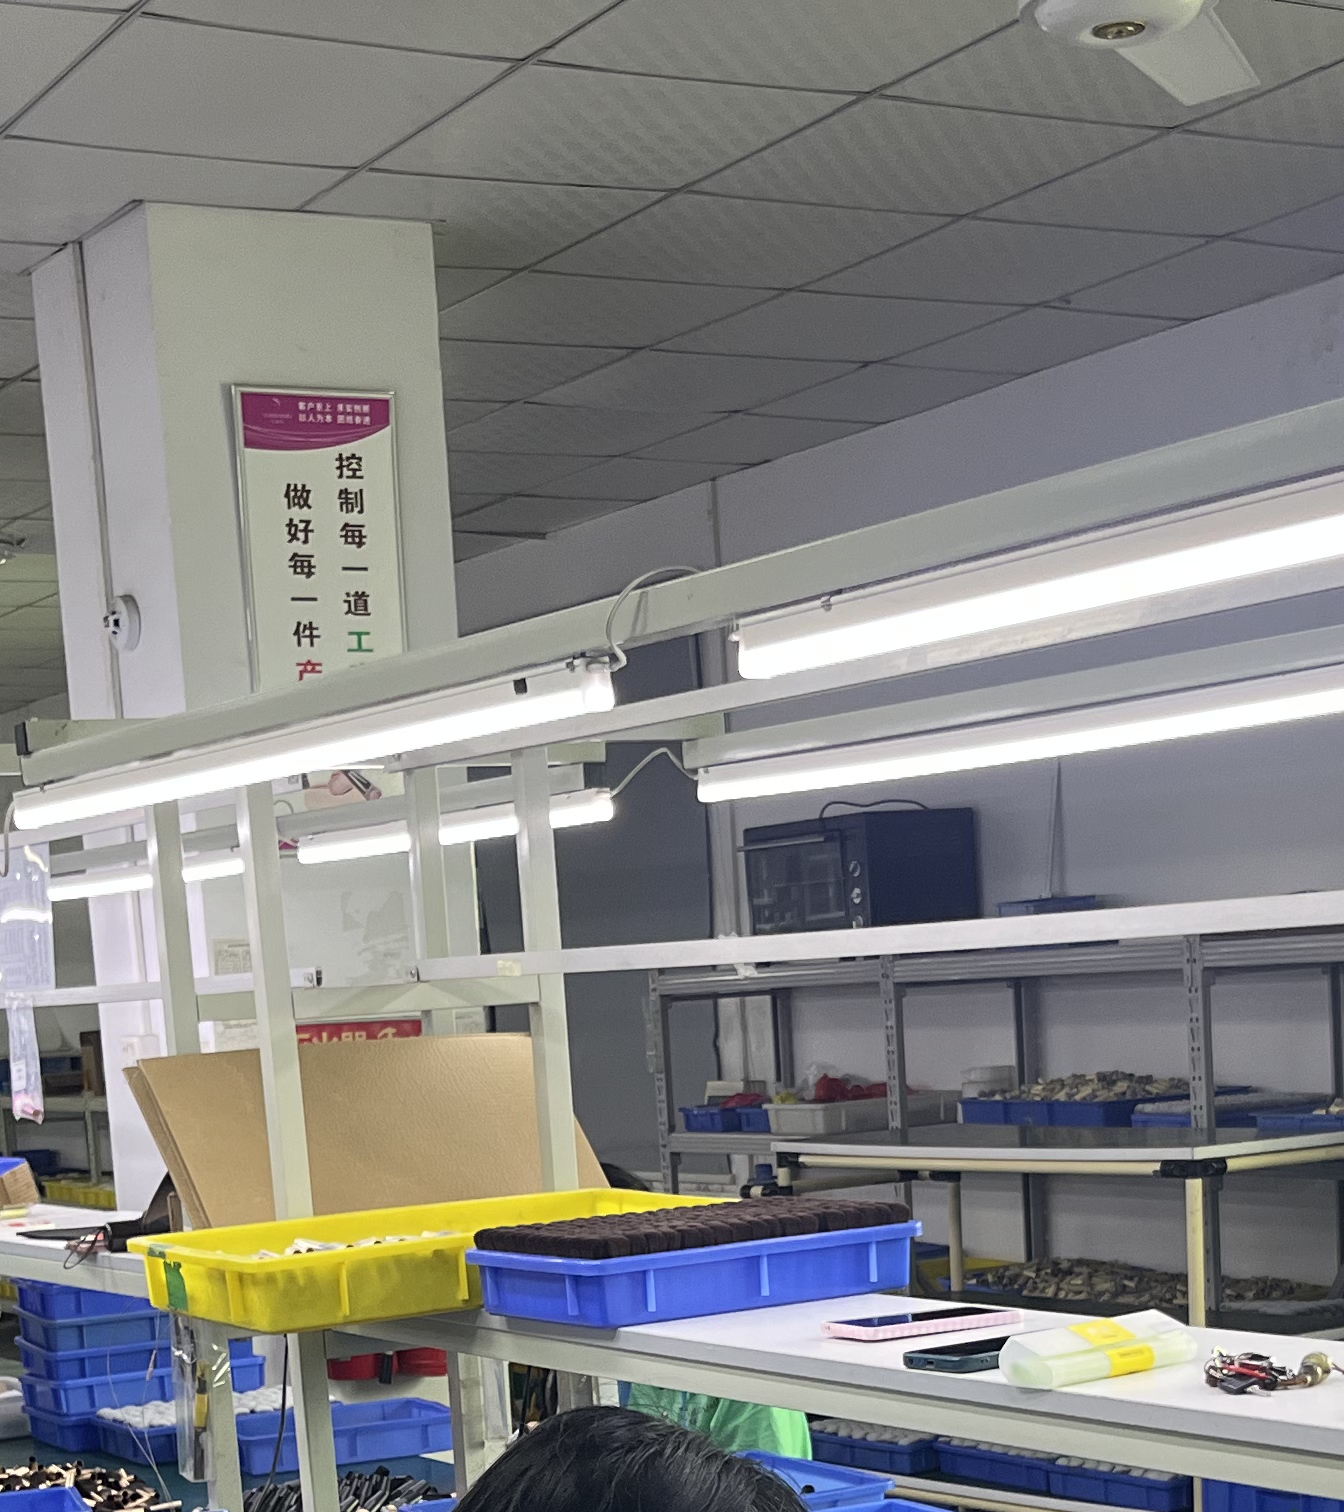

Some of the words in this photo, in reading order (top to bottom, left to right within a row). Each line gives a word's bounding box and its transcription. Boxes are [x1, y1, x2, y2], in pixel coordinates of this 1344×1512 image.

[335, 453, 374, 667] 控制每一道工
